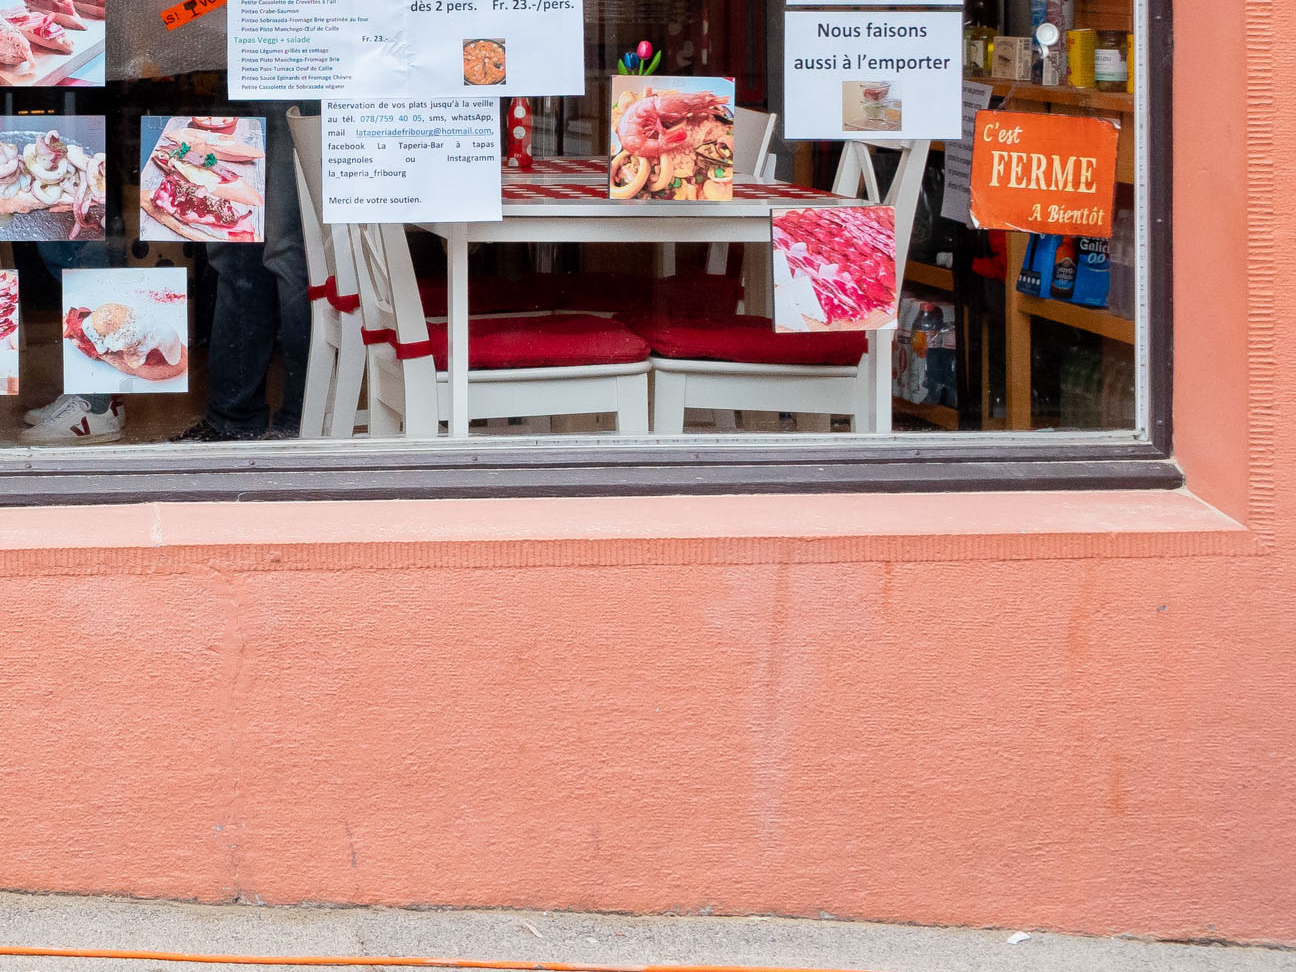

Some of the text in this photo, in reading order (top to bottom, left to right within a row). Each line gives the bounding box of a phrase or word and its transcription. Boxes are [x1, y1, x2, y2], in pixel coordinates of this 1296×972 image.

[410, 0, 432, 13] dès
[435, 0, 443, 12] 2
[446, 2, 478, 14] pers.
[492, 0, 509, 11] Fr.
[817, 22, 928, 38] Nous faisons
[233, 36, 256, 45] Tapas
[256, 36, 279, 45] Veggi
[286, 35, 311, 44] salade
[362, 35, 372, 43] Fr.
[793, 54, 837, 70] aussi
[842, 53, 852, 70] à
[327, 101, 376, 110] Réservation
[378, 101, 389, 109] de
[408, 100, 428, 110] plats
[462, 100, 470, 108] la
[472, 100, 494, 108] veille
[342, 115, 356, 123] tél.
[360, 114, 394, 124] 078/759
[398, 114, 409, 123] 40
[412, 114, 425, 123] 05,
[428, 115, 447, 123] sms,
[450, 113, 494, 123] whatsApp,
[983, 122, 1023, 144] C’est
[327, 141, 495, 151] facebook La Taperia-Bar à tapas
[327, 155, 374, 165] espagnoles
[446, 154, 495, 164] Instagramm
[328, 169, 407, 179] la_taperia_fribourg
[989, 151, 1097, 194] FERME
[328, 195, 422, 205] Merci de votre soutien.
[1028, 203, 1105, 226] A Bientôt
[1079, 238, 1110, 254] Galici
